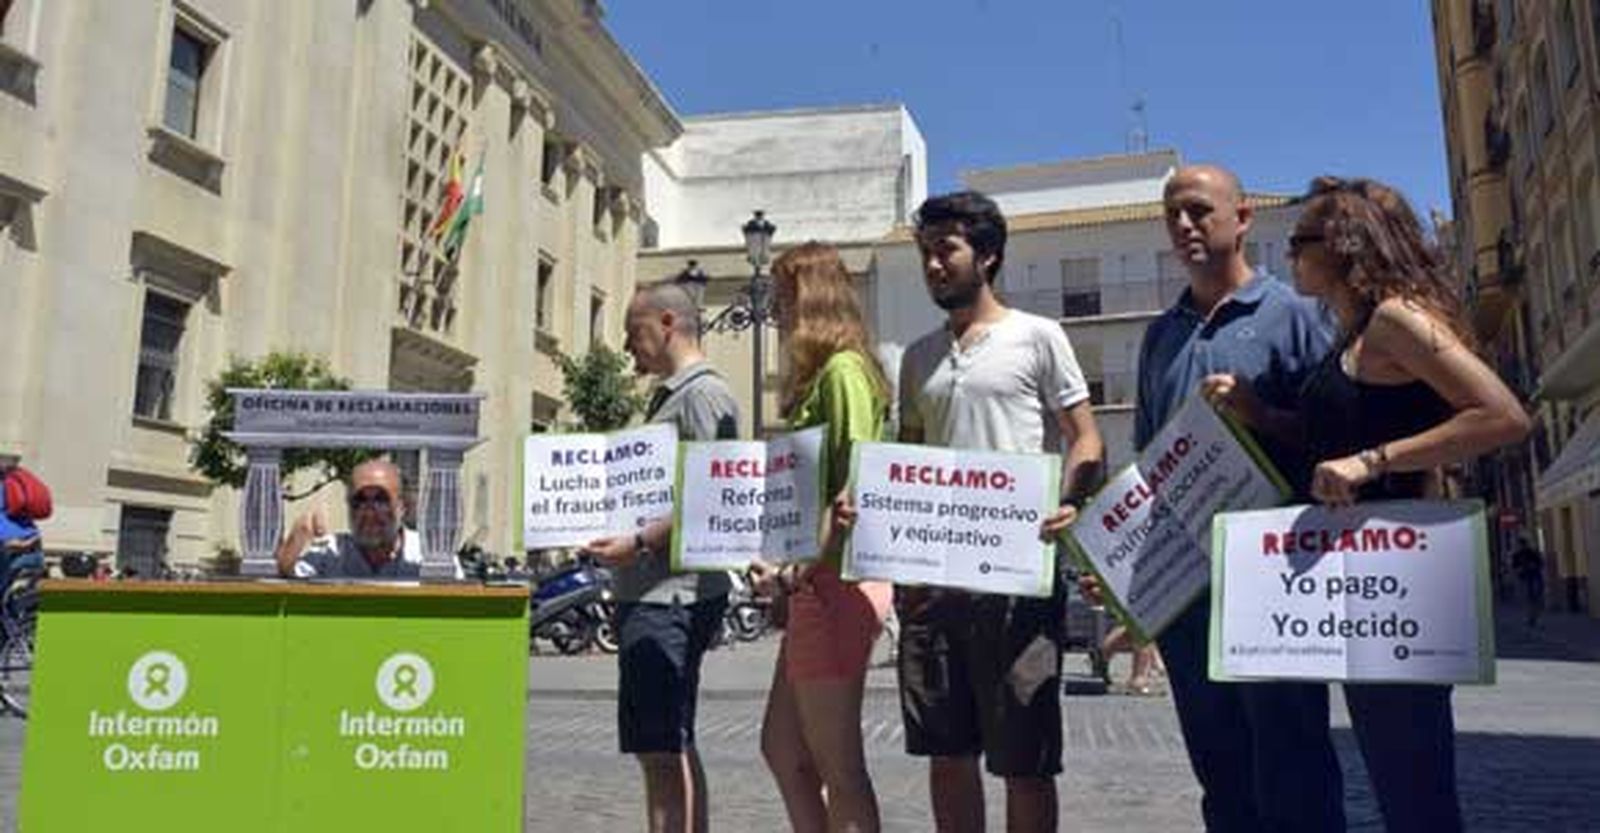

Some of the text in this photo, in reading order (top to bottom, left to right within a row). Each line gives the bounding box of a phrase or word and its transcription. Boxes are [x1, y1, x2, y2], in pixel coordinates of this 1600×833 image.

[242, 396, 472, 415] OFICINA DE RECLAMACIONES
[551, 441, 654, 466] RECLAMO:
[539, 465, 666, 492] Lucha contra
[888, 463, 1016, 492] RECLAMO:
[1102, 431, 1198, 533] RECLAMO:
[531, 485, 675, 515] el fraude fiscal
[720, 485, 794, 507] Reforma
[860, 493, 1039, 523] Sistema progresivo
[708, 514, 764, 533] fiscal
[890, 525, 1003, 549] y equitativo
[1262, 526, 1428, 555] RECLAMO:
[1281, 572, 1409, 600] Yo pago,
[1272, 613, 1420, 639] Yo decido
[88, 711, 219, 737] Intermón
[339, 711, 465, 737] Intermón
[104, 743, 200, 771] Oxfam
[355, 743, 449, 770] Oxfam
